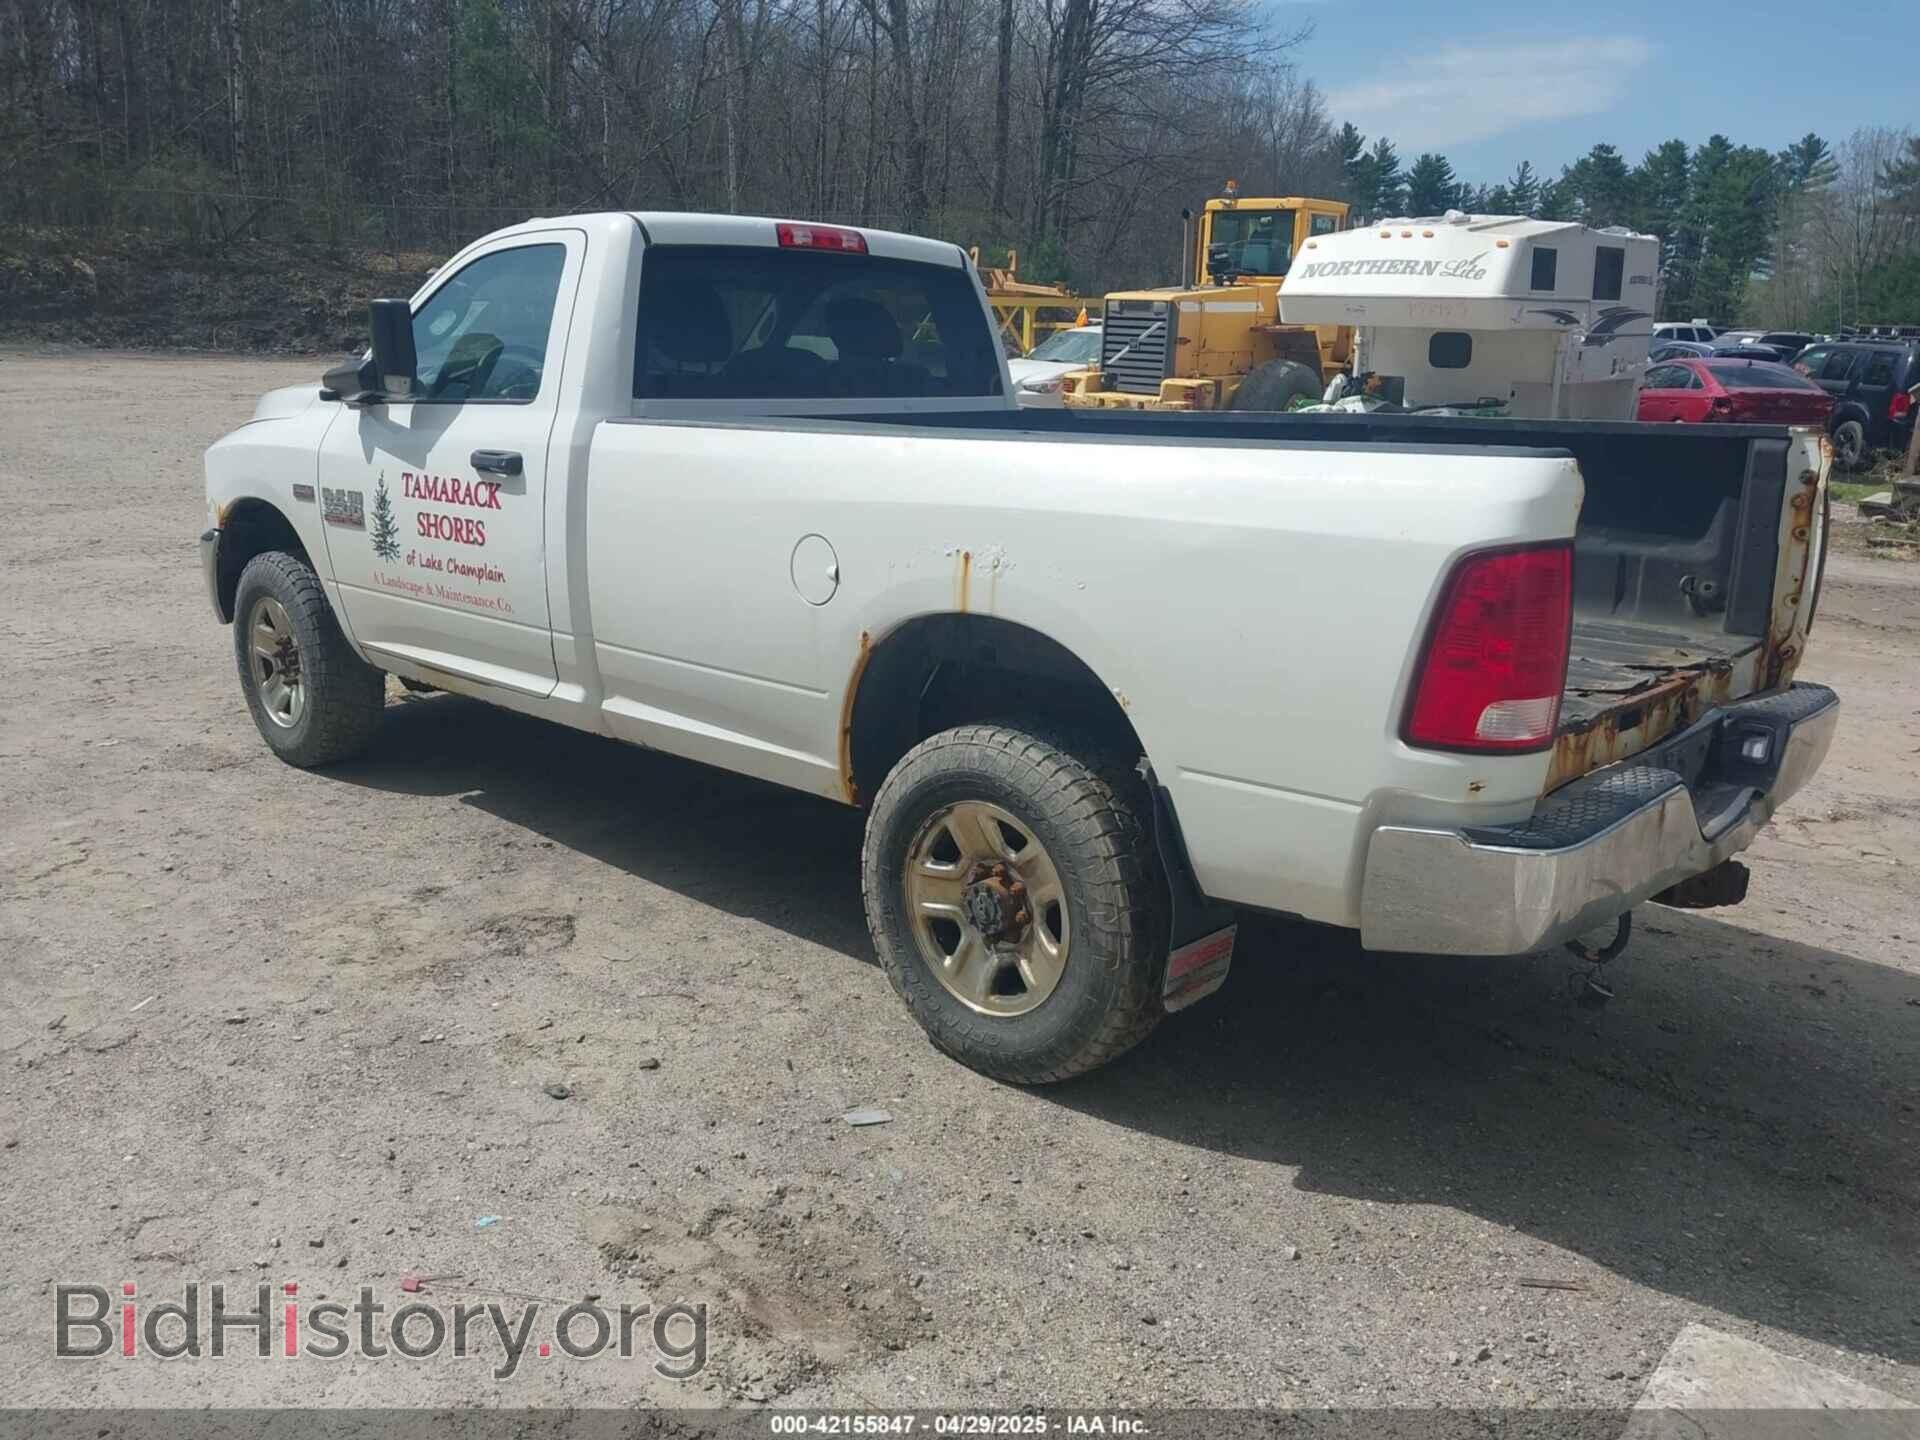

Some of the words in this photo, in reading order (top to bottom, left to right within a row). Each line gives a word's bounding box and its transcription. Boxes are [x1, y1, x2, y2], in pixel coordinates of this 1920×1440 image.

[1300, 259, 1444, 280] NORTHERN
[1439, 252, 1488, 281] Lite
[401, 472, 502, 510] TAMARACK
[417, 512, 486, 547] SHORES
[406, 549, 416, 566] of
[419, 554, 443, 572] Lake
[446, 559, 506, 584] Champlain
[381, 572, 425, 596] Landscape
[434, 585, 496, 609] Maintenance
